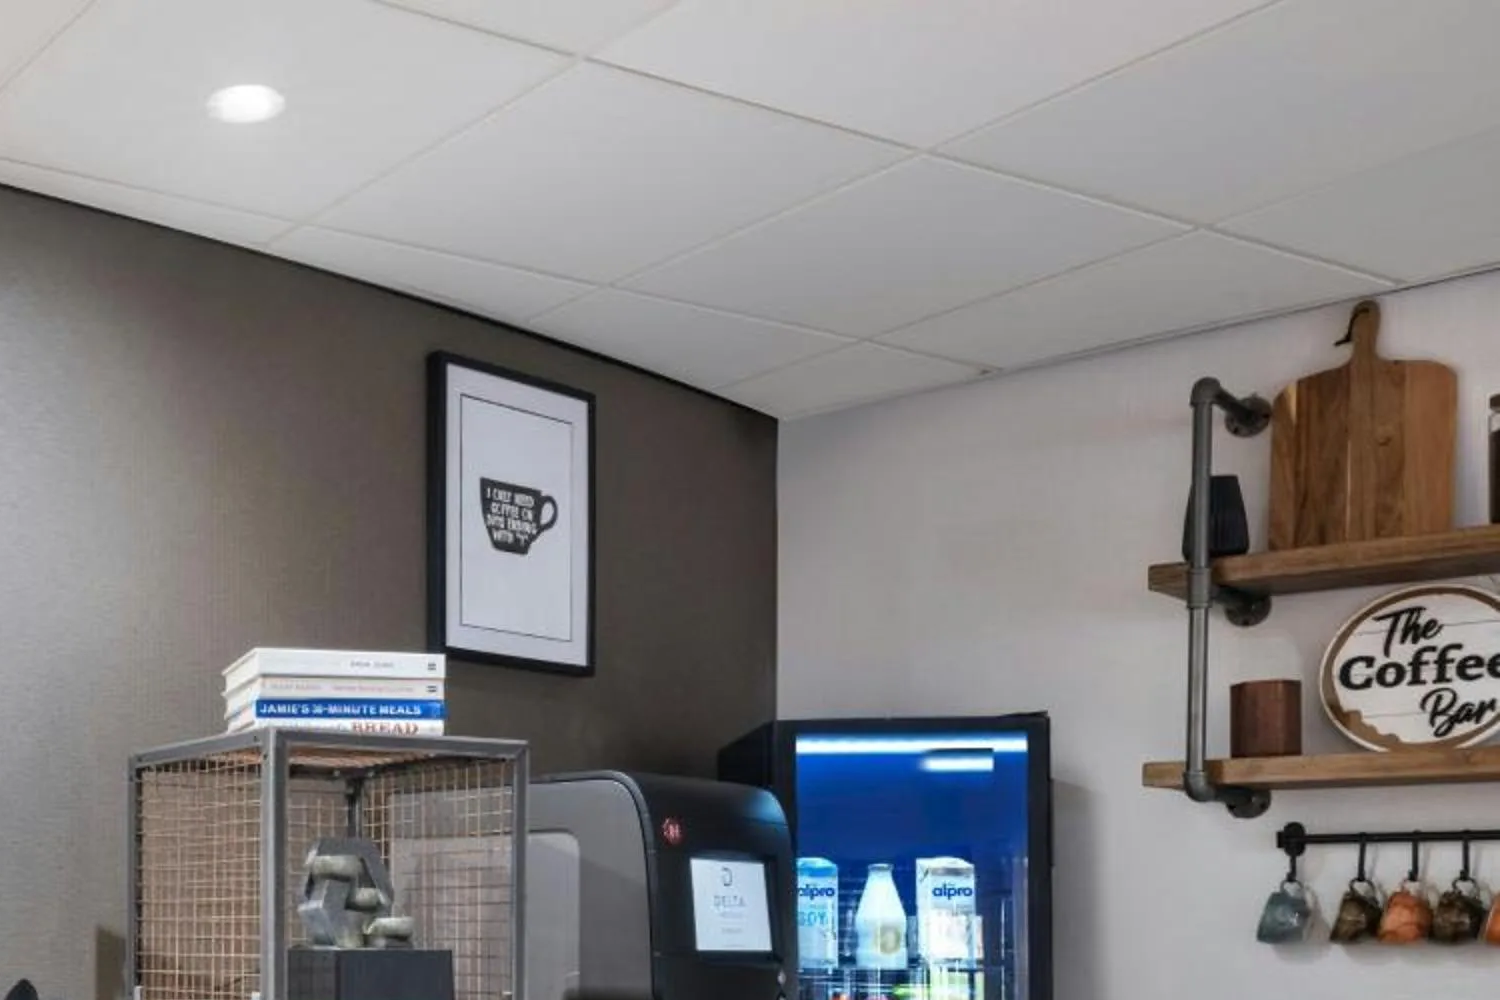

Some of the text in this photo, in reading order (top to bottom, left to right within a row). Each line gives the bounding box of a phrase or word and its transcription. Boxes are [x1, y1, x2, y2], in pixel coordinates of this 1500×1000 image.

[1372, 606, 1444, 658] The
[260, 703, 310, 715] JAMIE'S
[379, 704, 421, 715] MEALS
[1419, 687, 1496, 737] Bar
[797, 883, 835, 901] alpro
[932, 883, 973, 901] alpro
